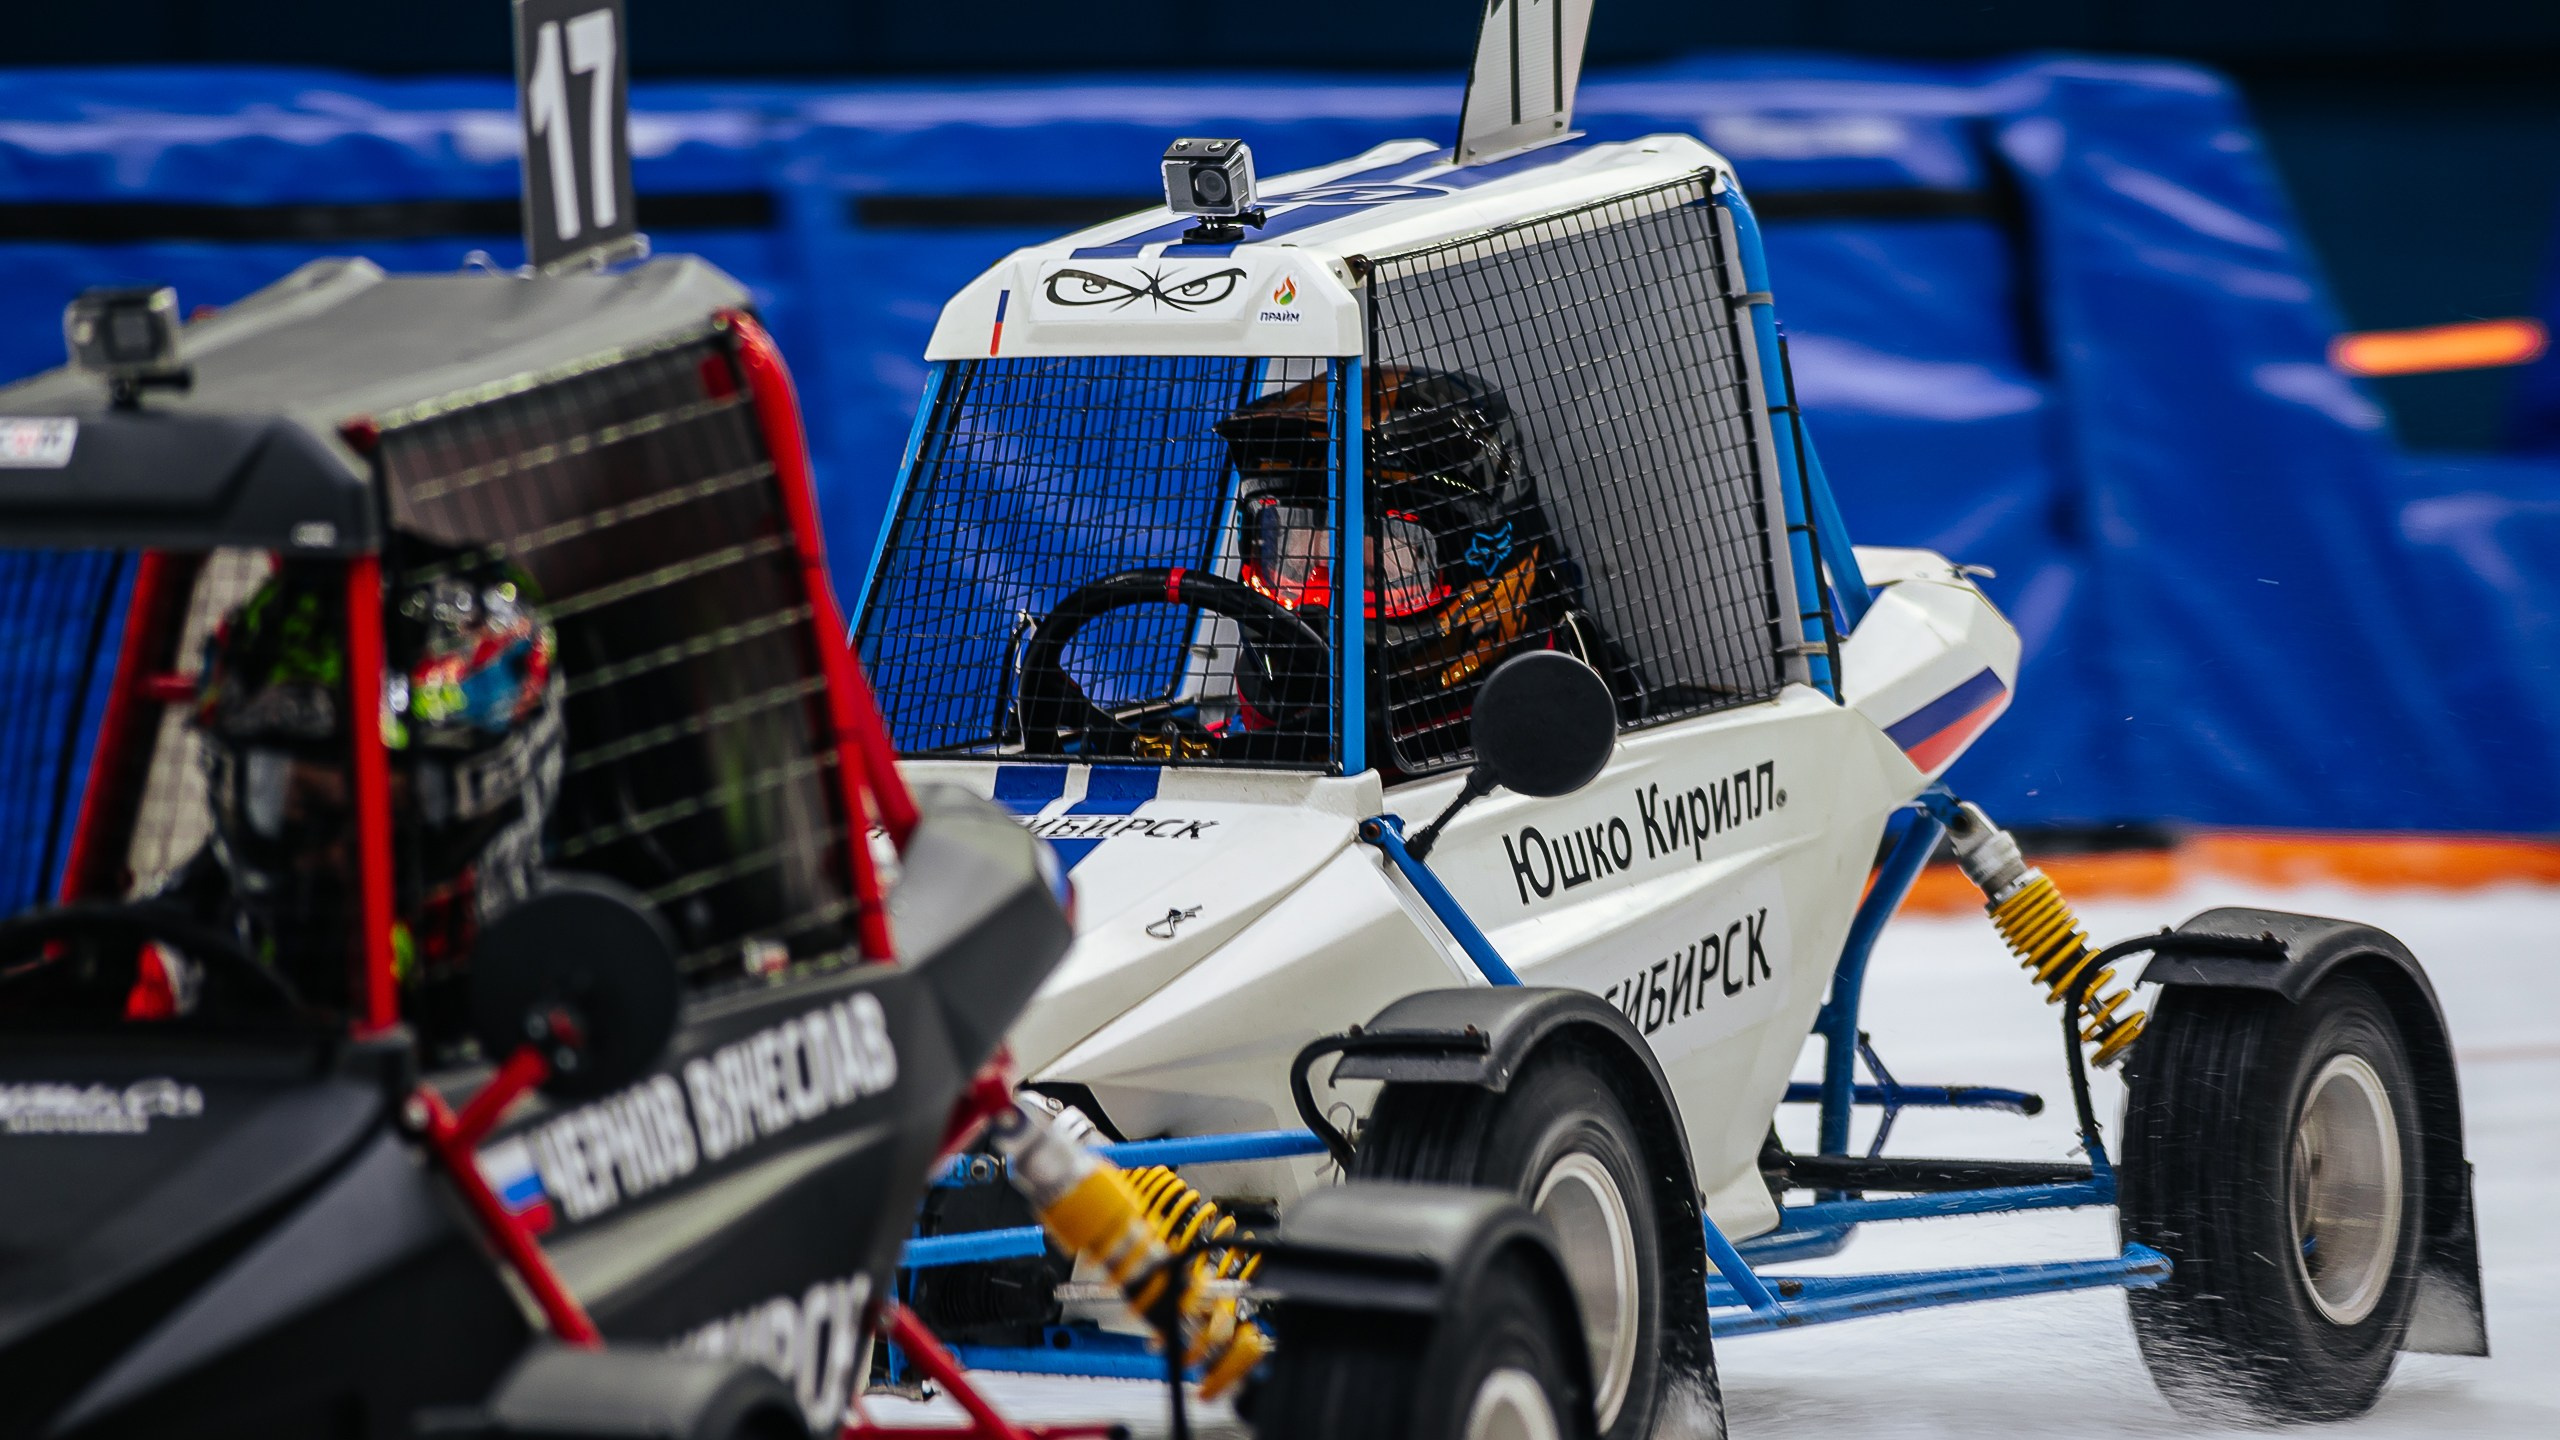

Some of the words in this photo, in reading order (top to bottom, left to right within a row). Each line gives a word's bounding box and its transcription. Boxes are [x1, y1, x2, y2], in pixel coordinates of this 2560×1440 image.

[529, 8, 617, 240] 17
[1260, 310, 1300, 322] ПРАЙМ
[1502, 815, 1632, 906] Юшко
[1635, 759, 1774, 862] Кирилл
[1604, 906, 1772, 1037] ИБИРСК
[532, 1073, 698, 1222] ЧЕРНОВ
[683, 991, 898, 1161] ВЯЧЕСЛАВ
